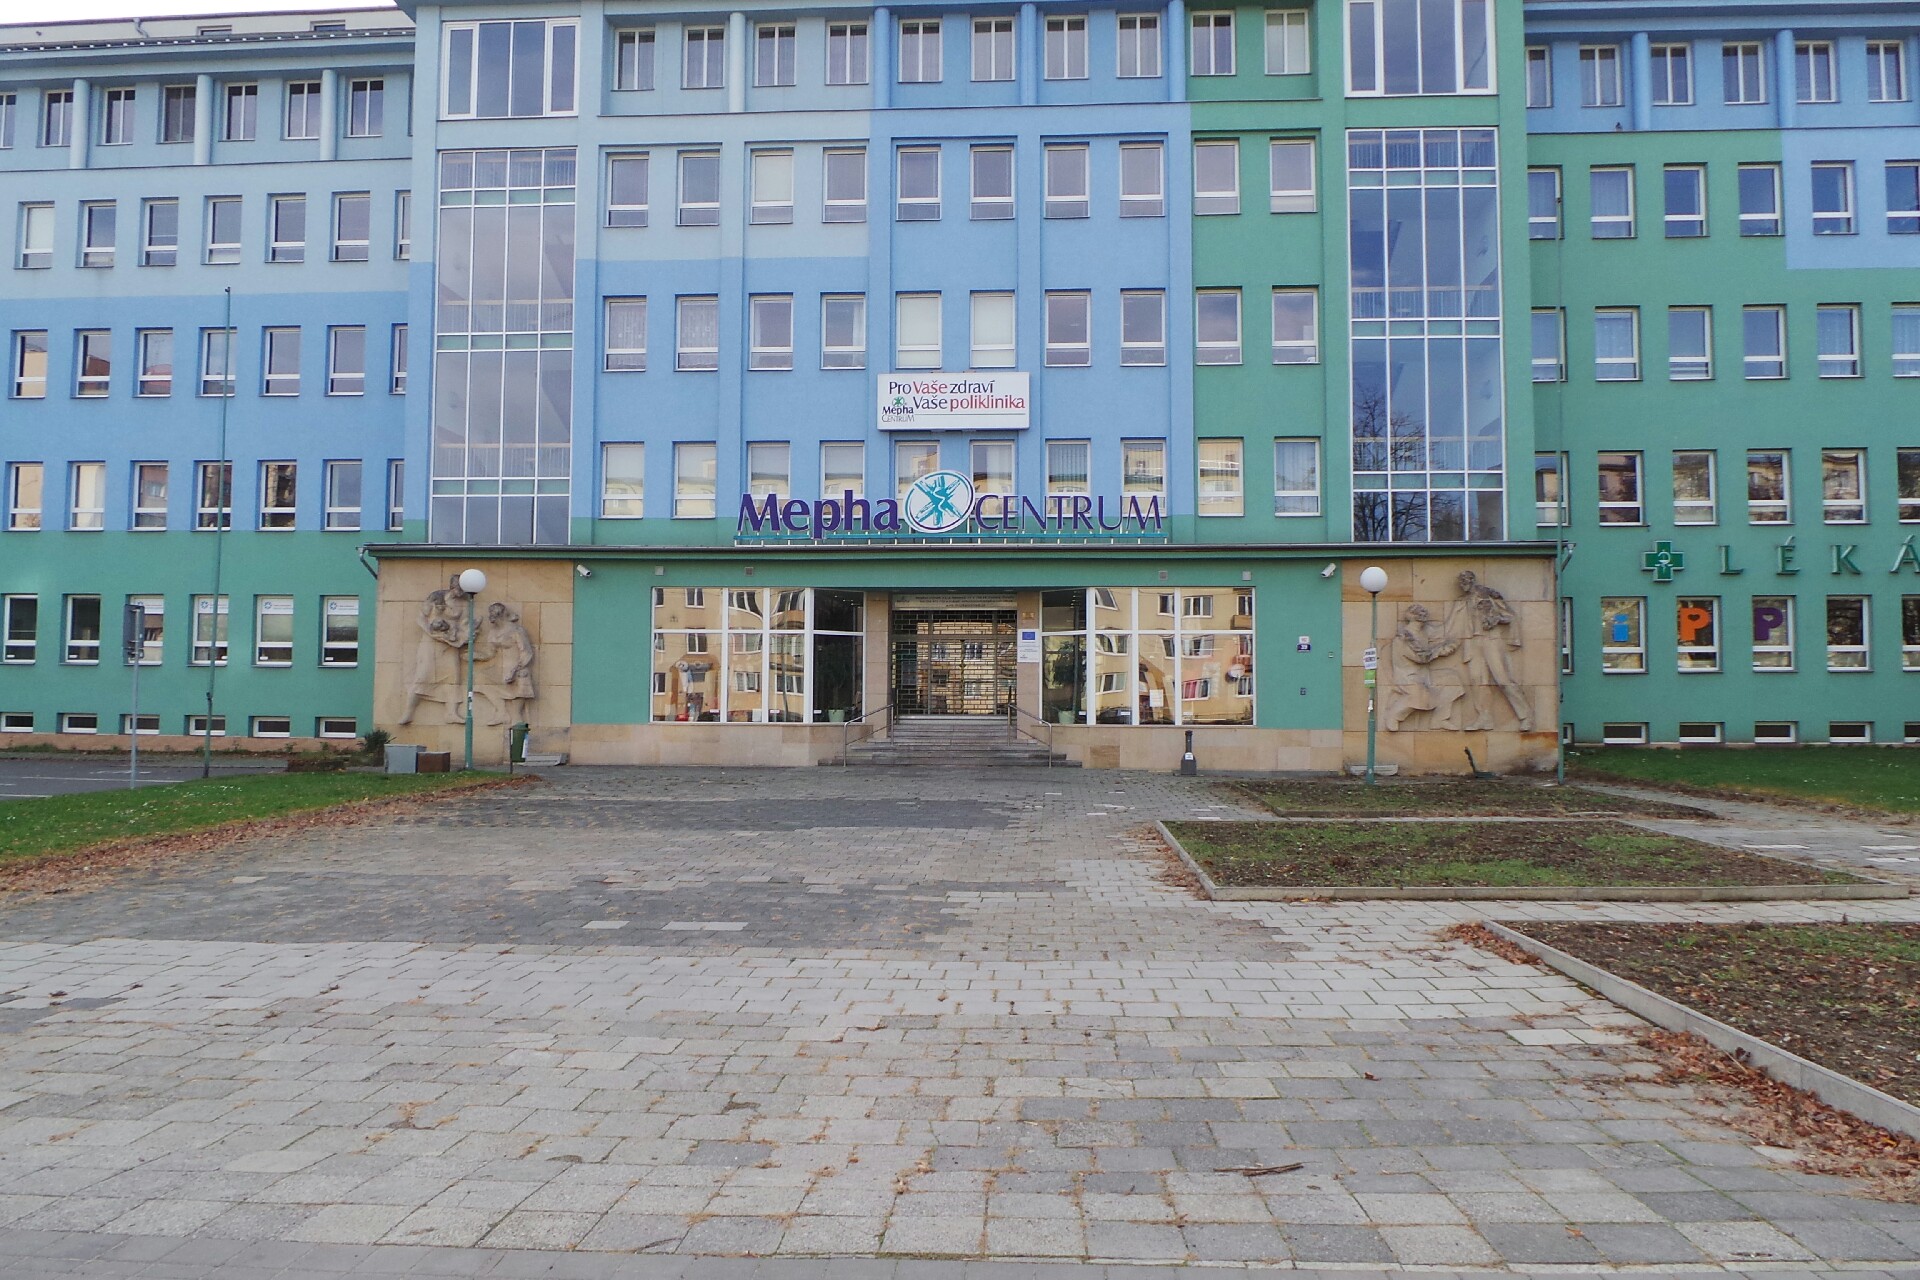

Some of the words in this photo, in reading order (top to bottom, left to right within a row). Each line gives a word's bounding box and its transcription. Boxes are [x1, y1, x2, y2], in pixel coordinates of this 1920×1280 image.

[889, 381, 912, 395] Pro
[913, 380, 947, 394] Vaše
[950, 380, 995, 394] zdraví
[882, 405, 914, 416] Mepha
[913, 395, 948, 410] Vaše
[950, 395, 1025, 412] poliklinika
[881, 415, 915, 423] CENTRUM
[737, 490, 901, 539] Mepha
[975, 494, 1163, 531] CENTRUM
[1678, 607, 1712, 641] P
[1754, 607, 1784, 641] P
